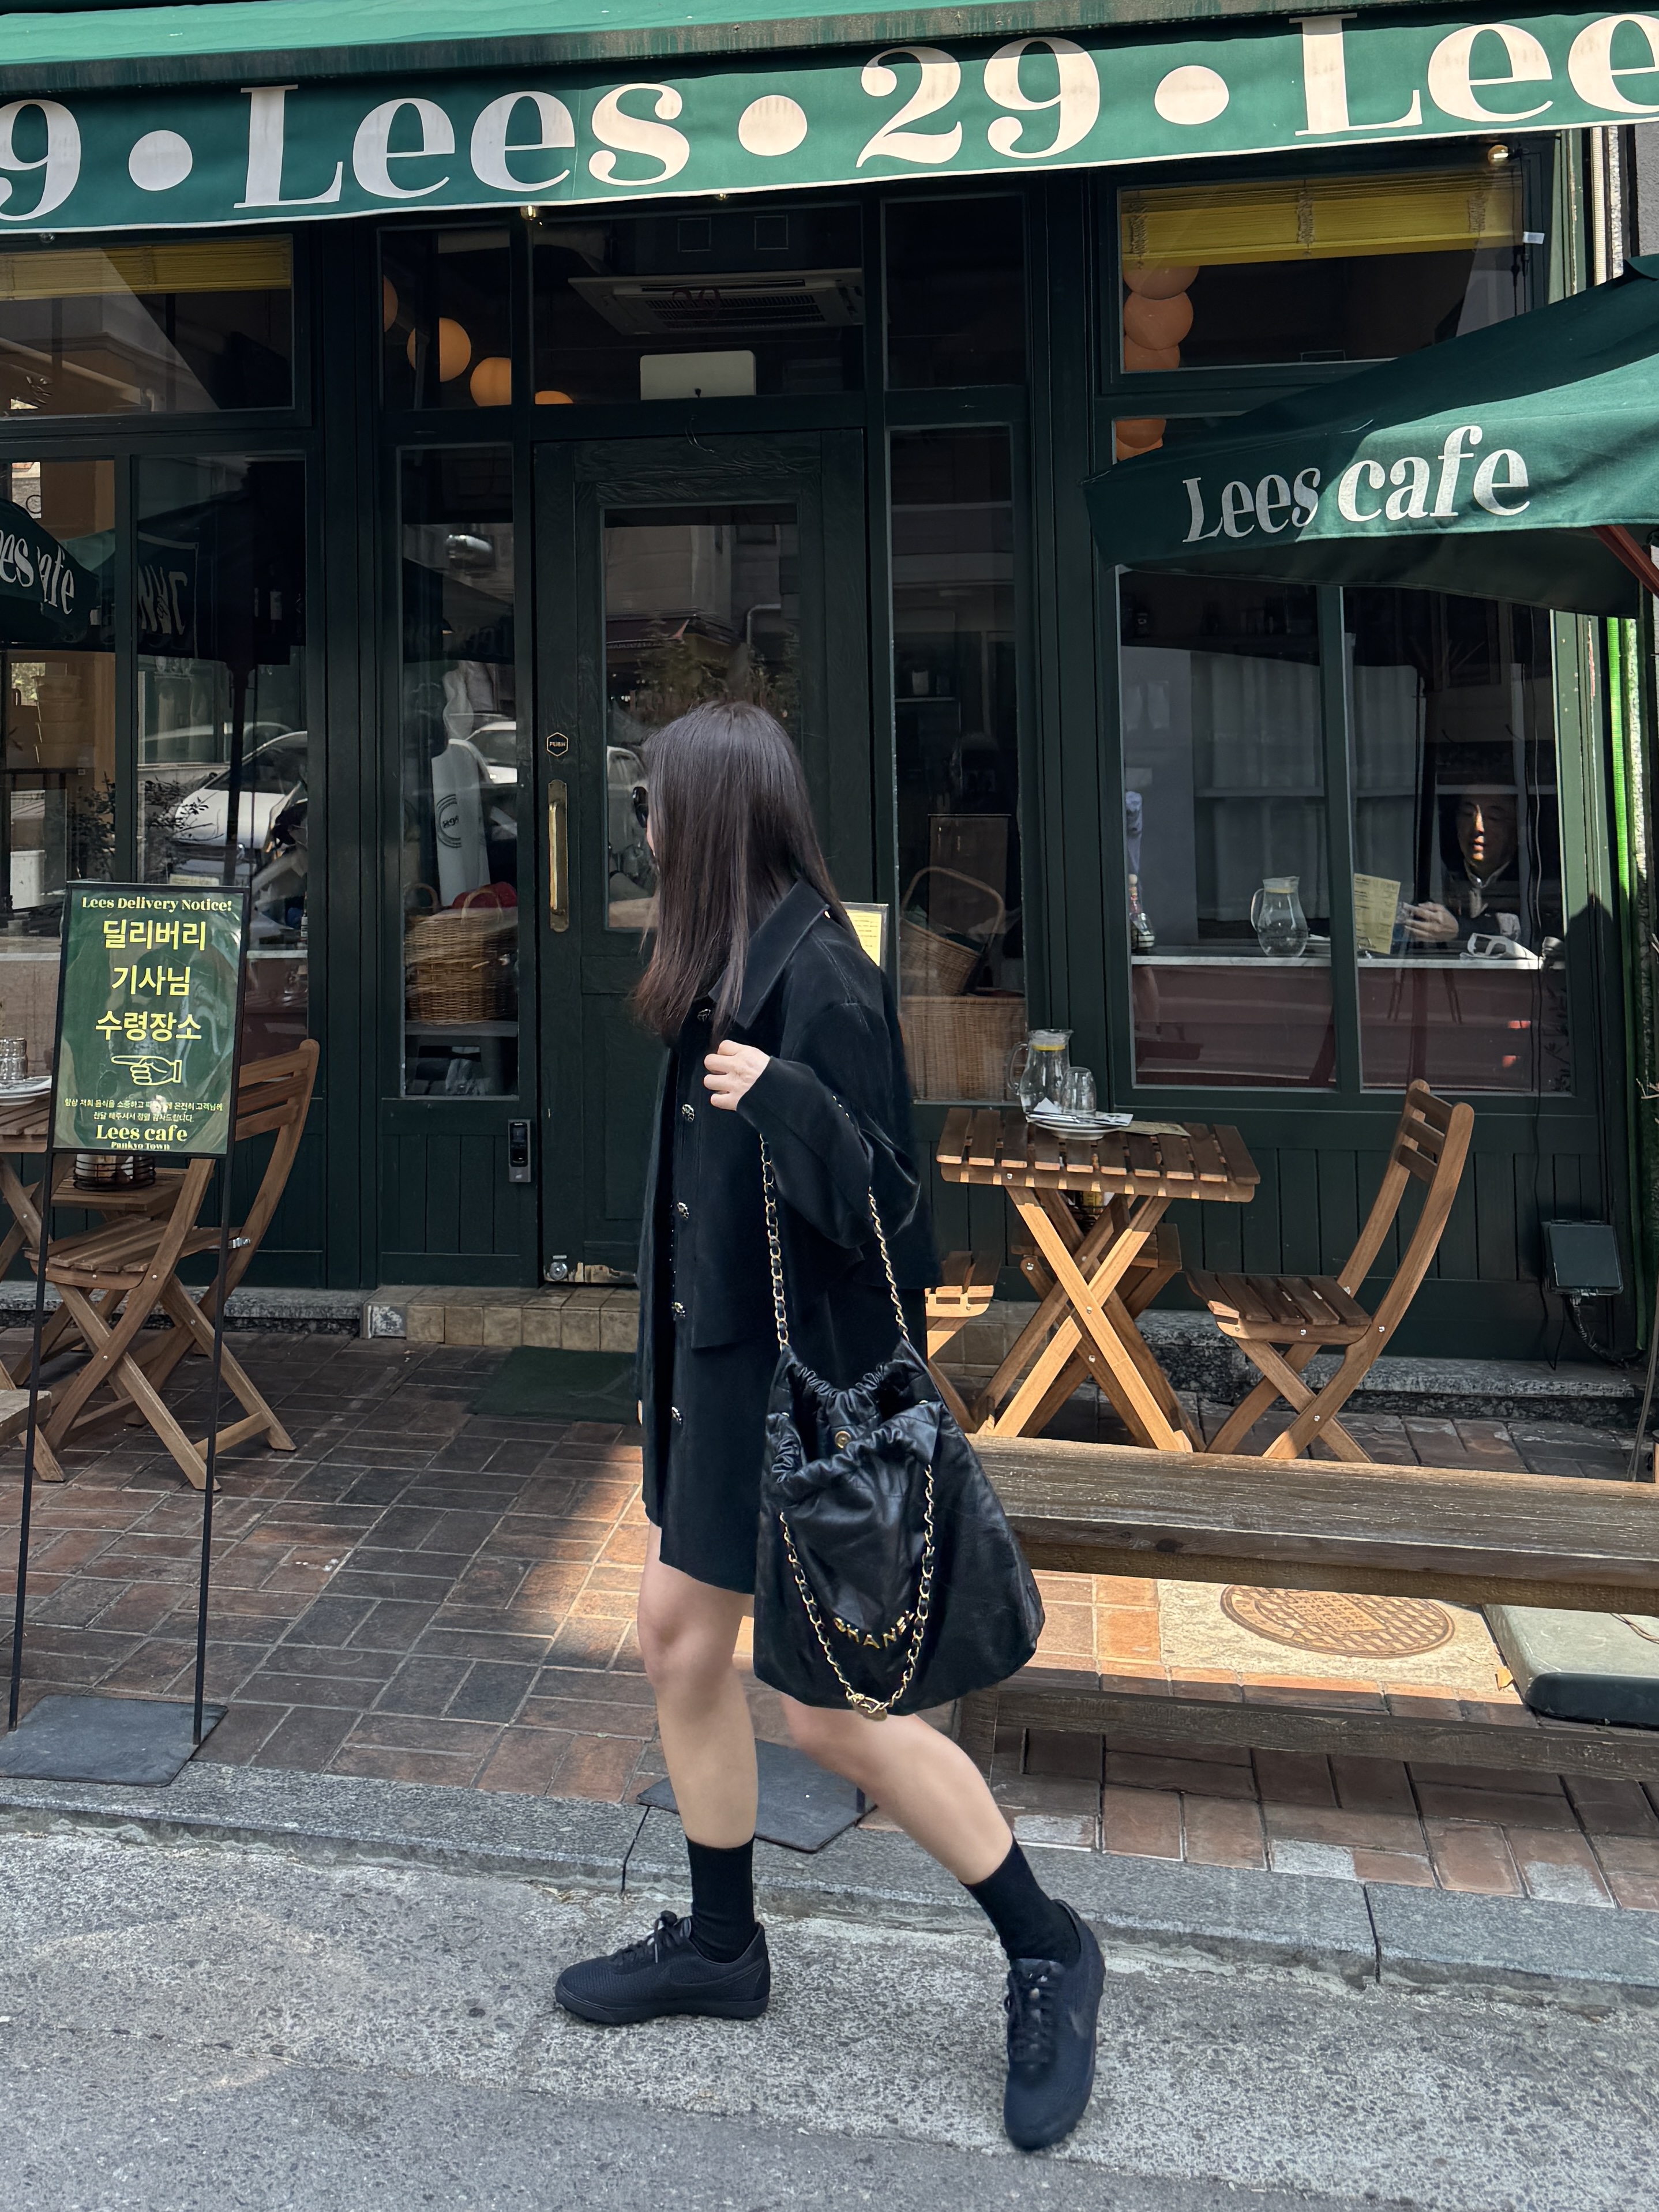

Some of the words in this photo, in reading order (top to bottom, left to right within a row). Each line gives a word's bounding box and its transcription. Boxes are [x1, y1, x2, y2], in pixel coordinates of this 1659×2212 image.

[234, 82, 690, 208] Lees
[855, 37, 1100, 168] 29
[1289, 13, 1659, 136] Lee
[1183, 467, 1321, 543] Lees
[1338, 425, 1530, 521] cafe
[82, 896, 115, 908] Lees
[117, 896, 179, 913] Delivery
[182, 898, 232, 911] Notice!
[103, 919, 207, 951] 딜리버리
[112, 965, 190, 996] 기사님
[95, 1011, 202, 1042] 수령장소
[96, 1124, 140, 1140] Lees
[144, 1124, 188, 1142] cafe
